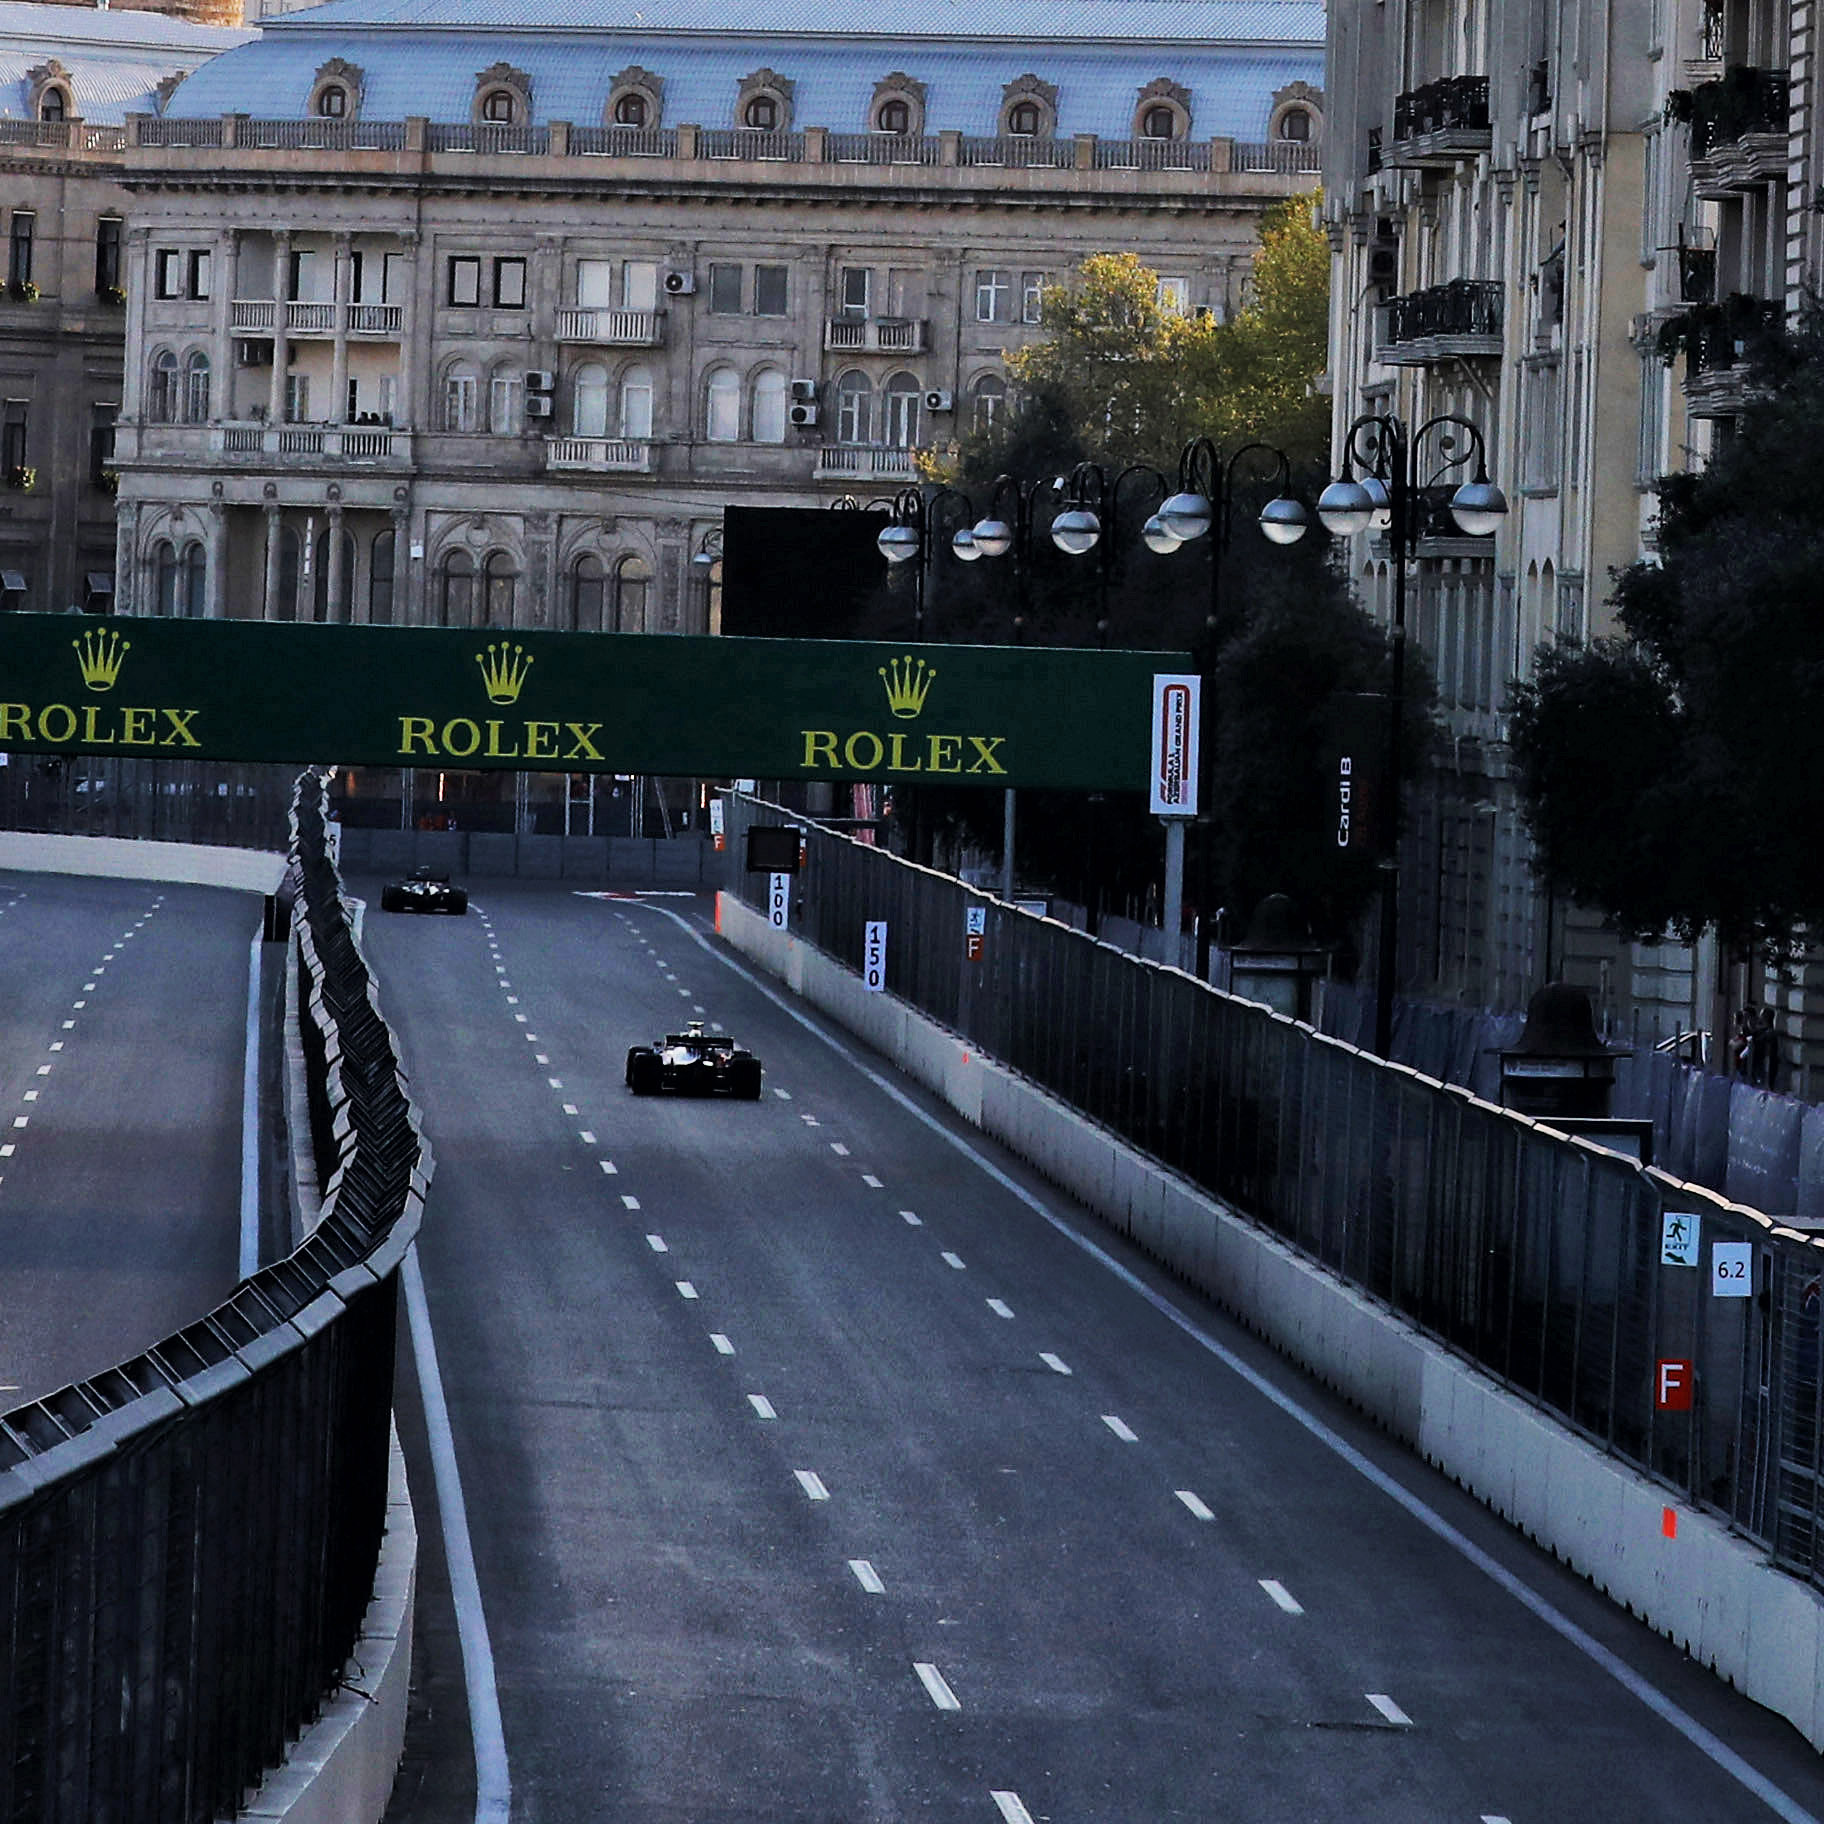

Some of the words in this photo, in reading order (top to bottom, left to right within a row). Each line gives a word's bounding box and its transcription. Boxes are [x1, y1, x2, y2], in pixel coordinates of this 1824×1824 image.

[397, 716, 605, 761] ROLEX
[800, 729, 1007, 775] ROLEX
[1339, 756, 1352, 776] B
[1337, 780, 1352, 847] Cardi
[714, 835, 721, 849] F
[773, 875, 784, 926] 100
[869, 925, 880, 987] 150
[968, 937, 980, 958] F
[1665, 1243, 1689, 1251] EXIT
[1718, 1261, 1745, 1279] 6.2
[1660, 1363, 1684, 1404] F
